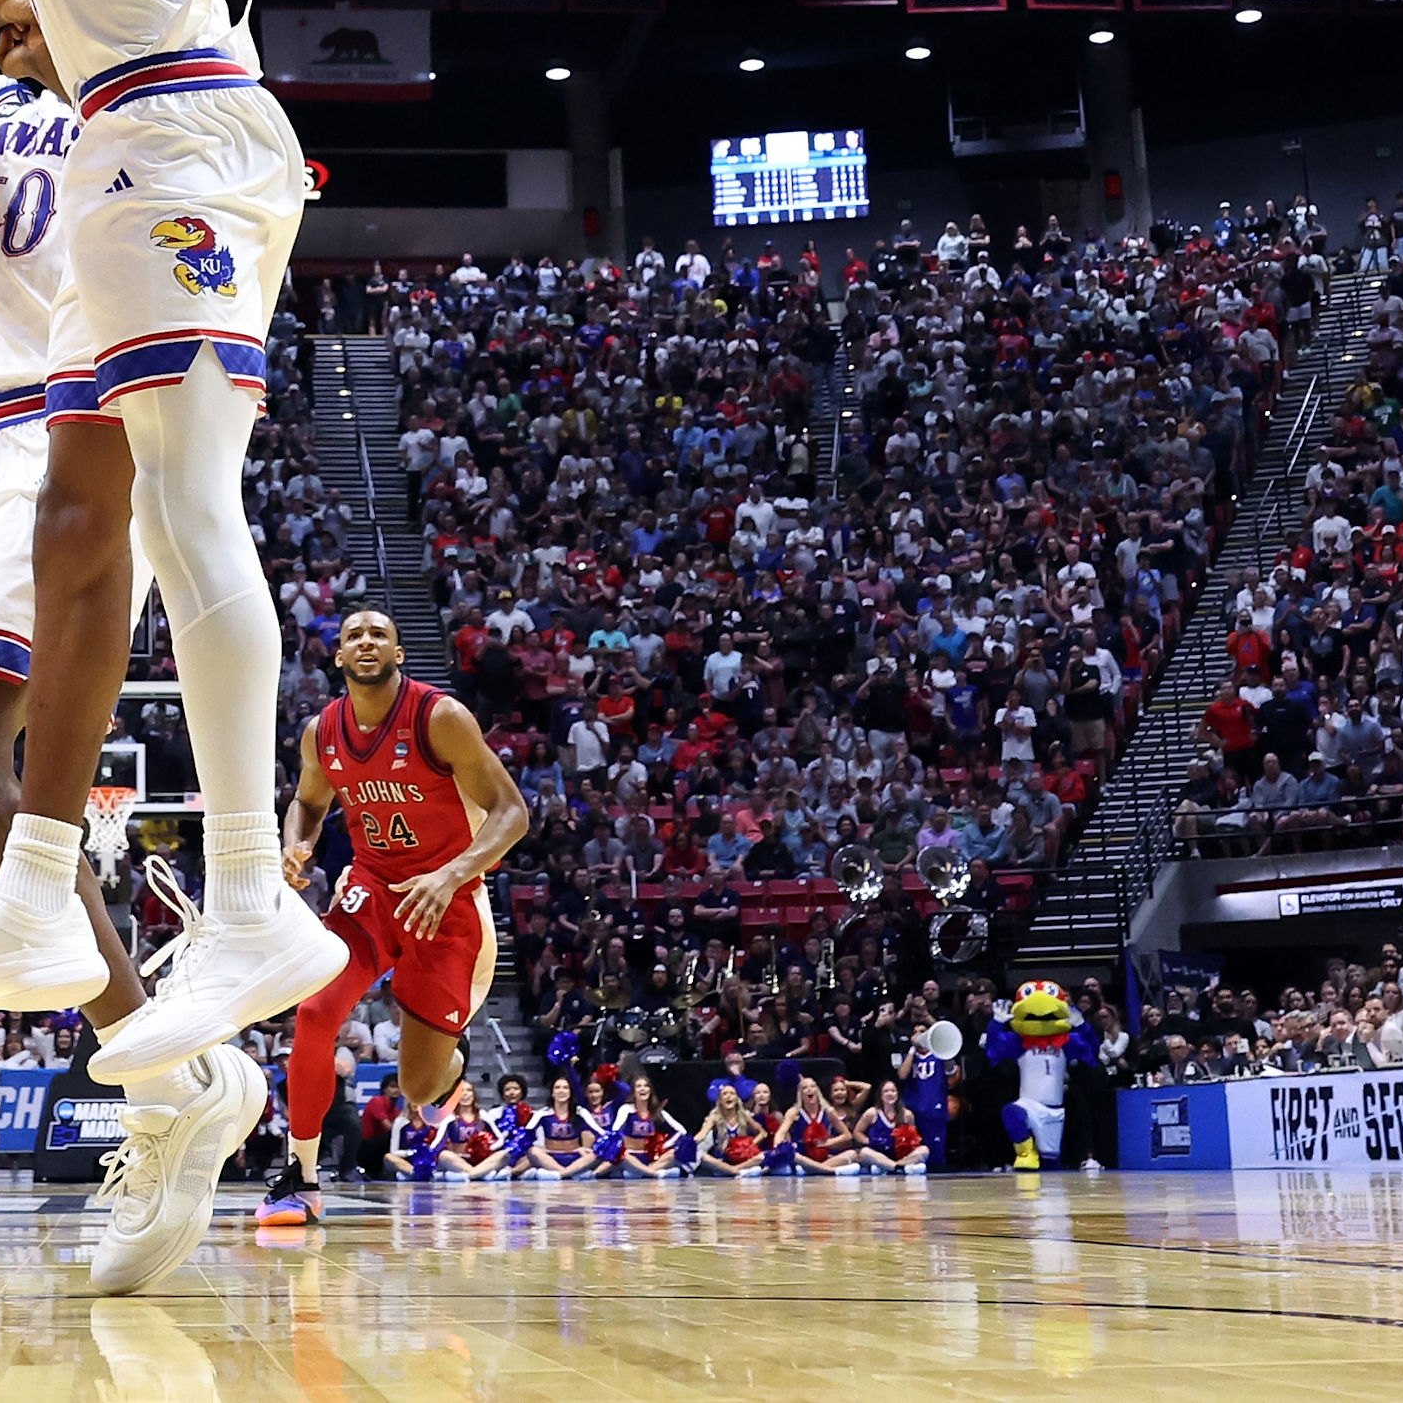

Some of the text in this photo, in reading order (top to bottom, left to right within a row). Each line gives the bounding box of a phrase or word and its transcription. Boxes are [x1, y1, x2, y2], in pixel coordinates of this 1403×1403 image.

[198, 257, 221, 276] KU
[357, 780, 424, 804] JOHN'S
[360, 811, 420, 850] 24
[1270, 1085, 1333, 1162] FIRST
[1334, 1107, 1362, 1139] AND
